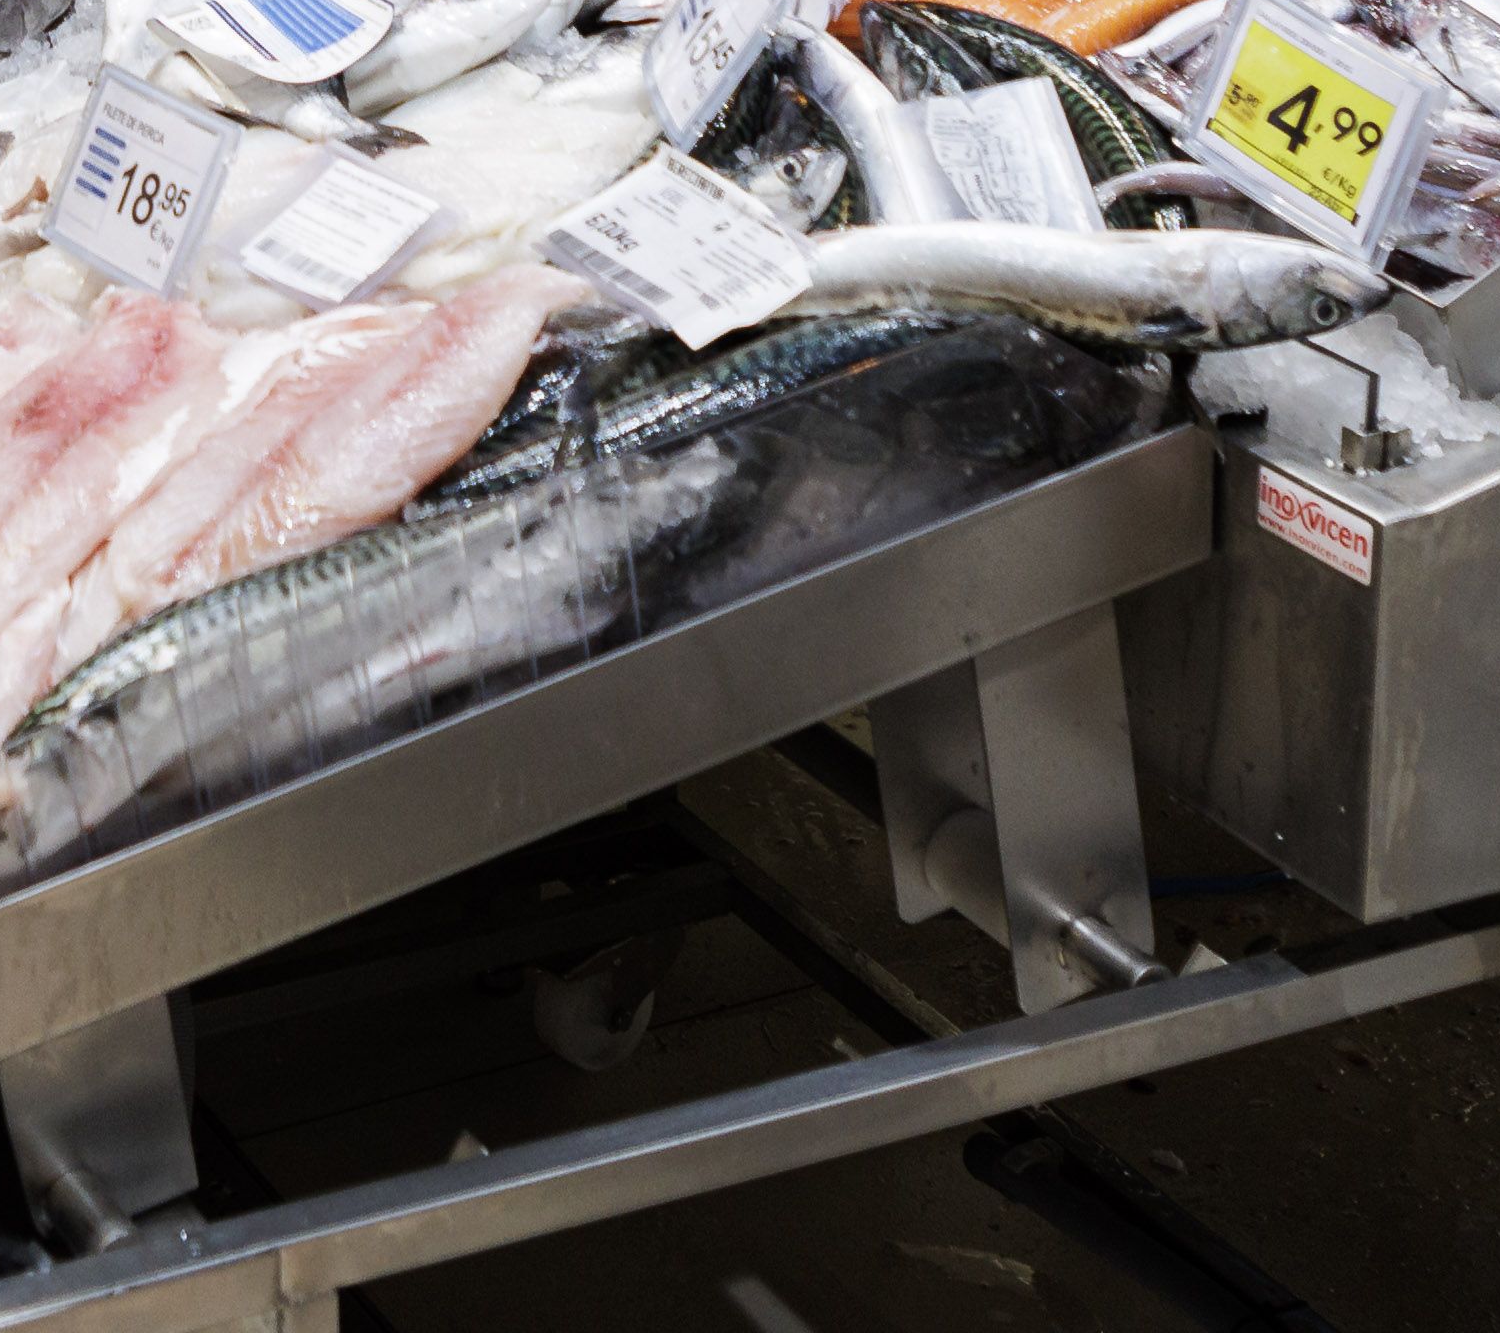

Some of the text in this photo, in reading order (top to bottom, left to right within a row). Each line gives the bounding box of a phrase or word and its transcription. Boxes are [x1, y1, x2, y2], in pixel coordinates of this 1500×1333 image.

[103, 101, 125, 124] FILETE
[126, 115, 137, 130] DE
[1267, 85, 1383, 156] 4,99
[117, 162, 192, 226] 18,95
[1321, 167, 1358, 199] €/Kg
[1260, 474, 1368, 558] inoxvicen
